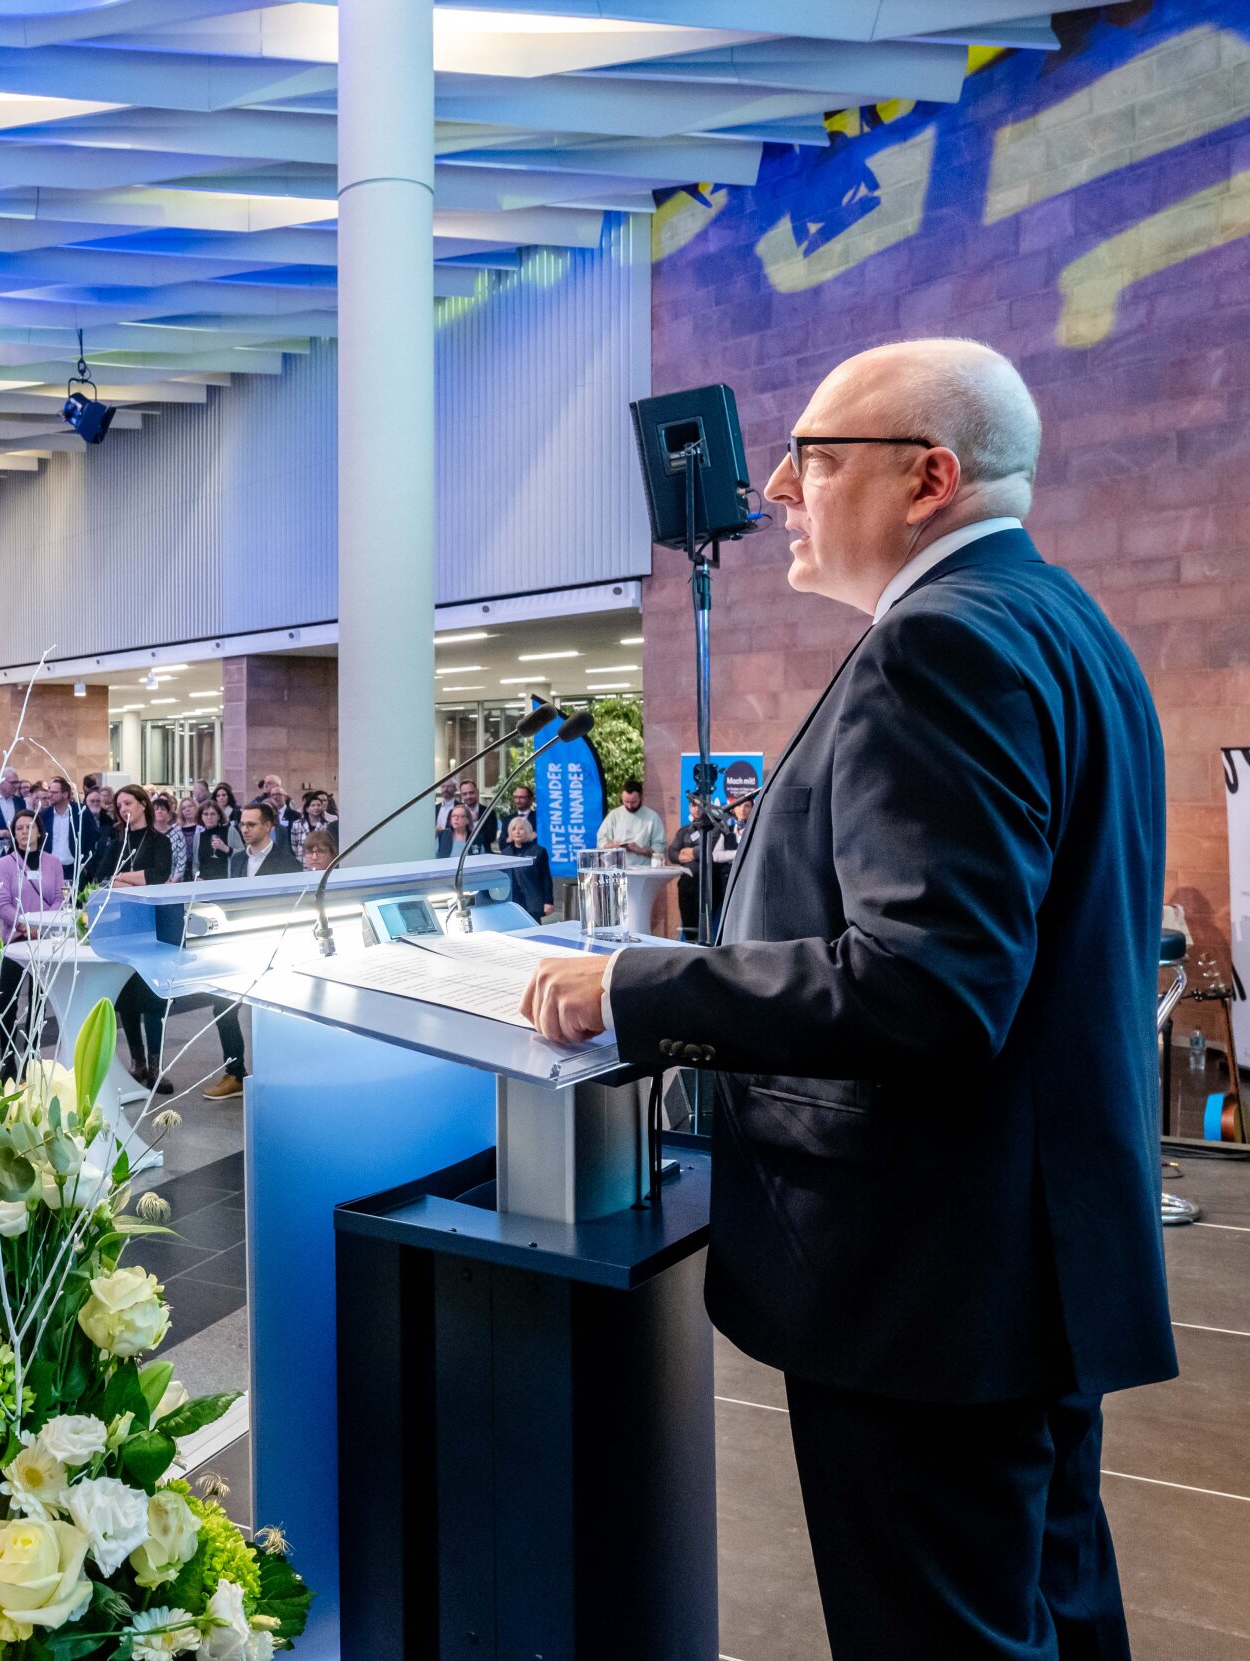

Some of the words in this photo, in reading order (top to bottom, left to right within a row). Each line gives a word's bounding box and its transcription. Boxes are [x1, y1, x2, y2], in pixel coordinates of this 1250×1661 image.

[726, 776, 743, 785] Mach
[743, 776, 756, 785] mit!
[547, 763, 568, 862] MITEINANDER
